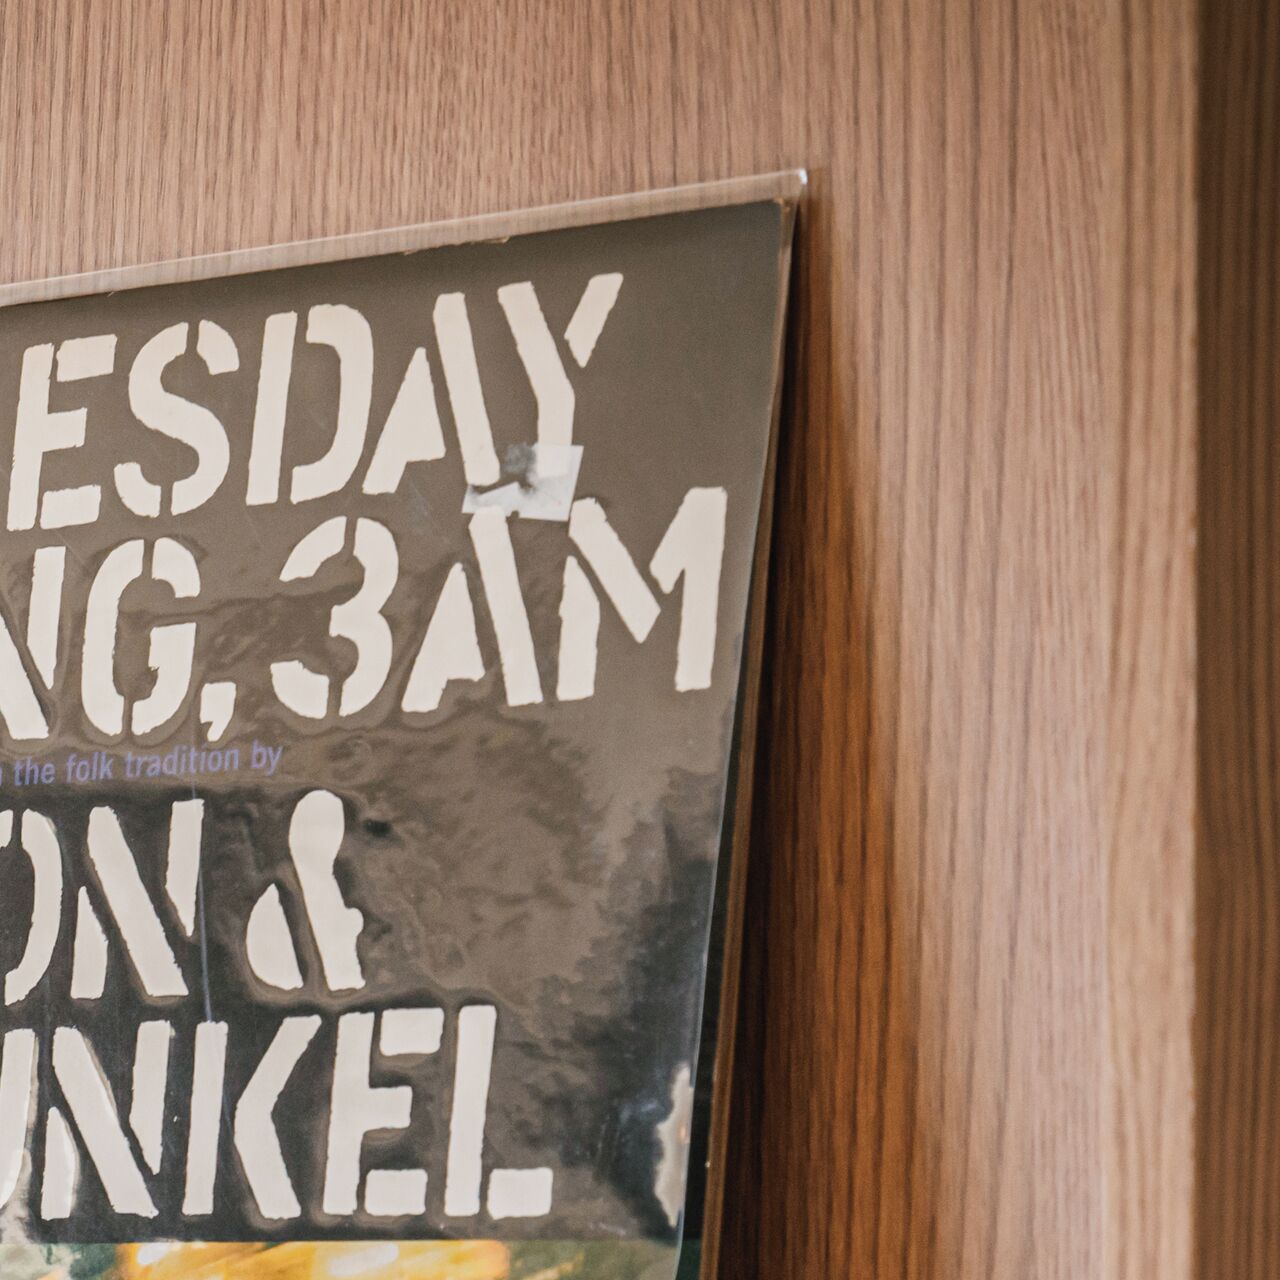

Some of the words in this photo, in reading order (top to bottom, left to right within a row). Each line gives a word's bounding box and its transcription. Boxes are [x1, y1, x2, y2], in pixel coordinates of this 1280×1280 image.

[13, 757, 56, 787] the
[65, 751, 114, 784] folk
[124, 743, 240, 779] tradition
[250, 739, 284, 775] by
[244, 790, 368, 993] &
